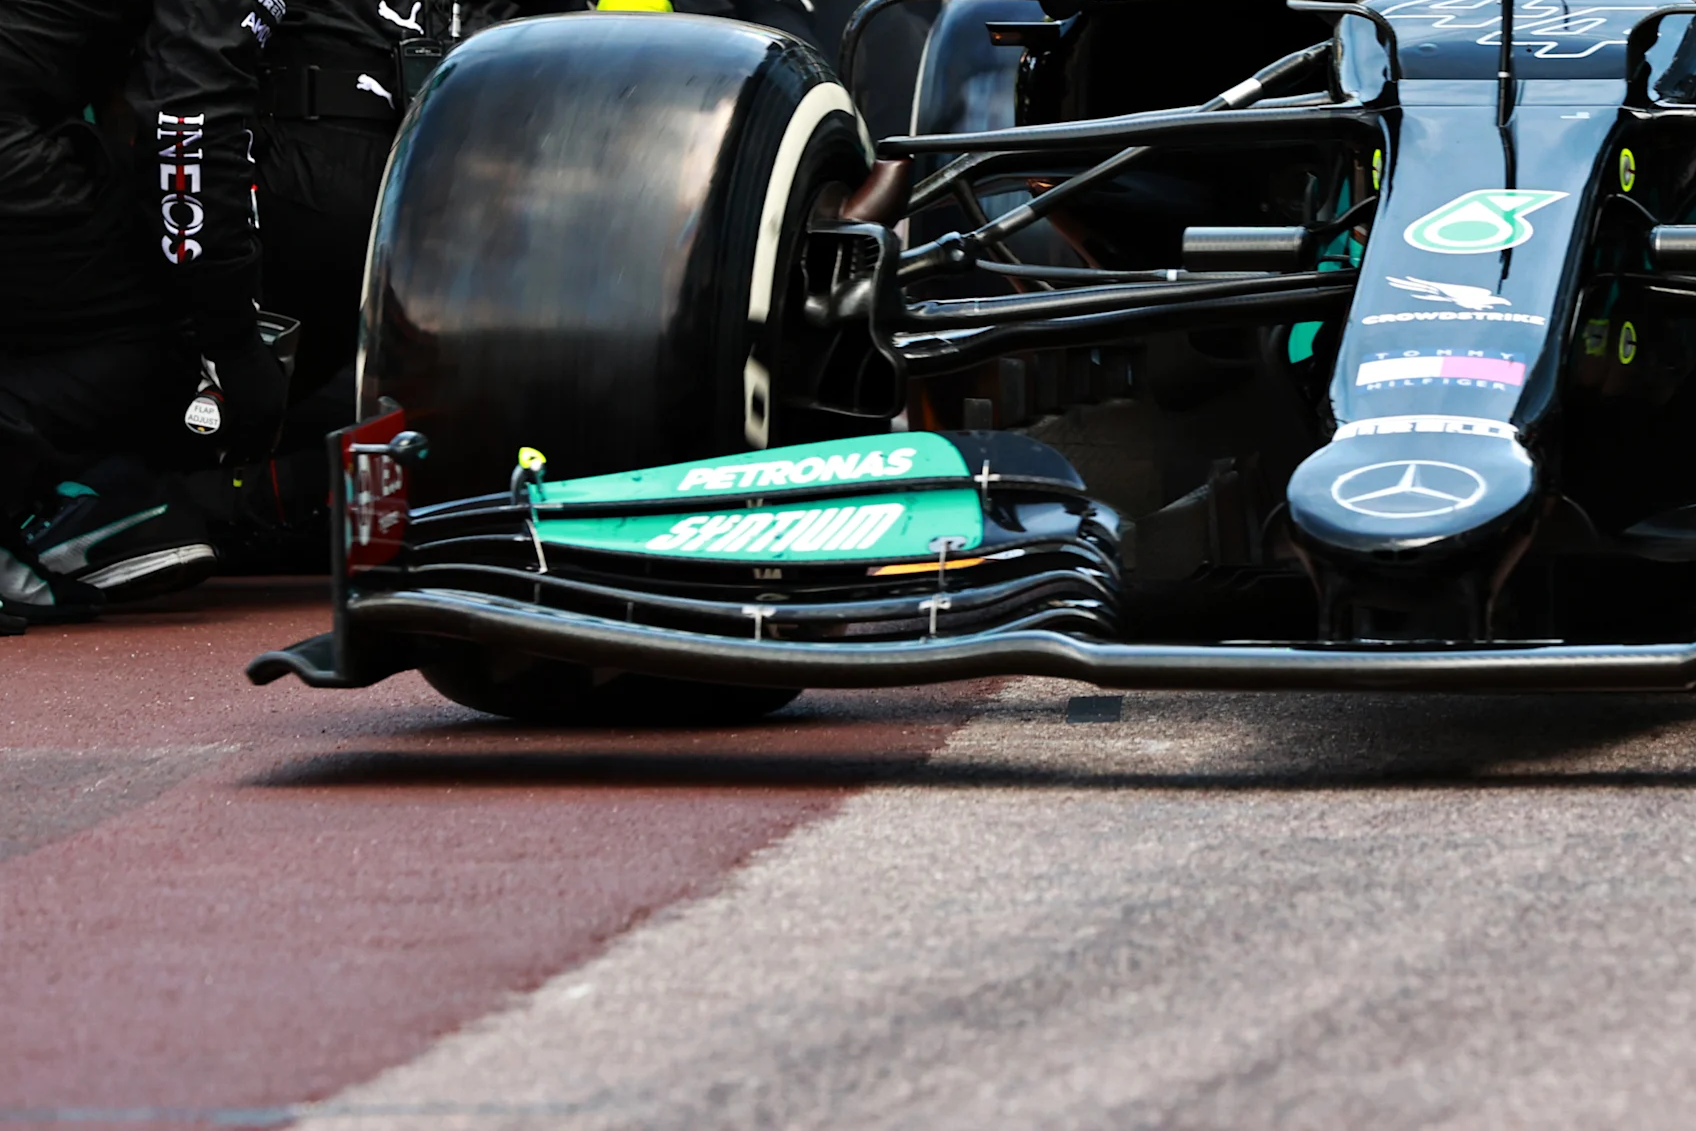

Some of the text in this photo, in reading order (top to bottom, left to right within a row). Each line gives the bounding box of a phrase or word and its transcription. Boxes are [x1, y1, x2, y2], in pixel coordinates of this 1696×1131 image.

[156, 111, 205, 265] INEOS
[1361, 311, 1546, 326] CROWDSTRIKE
[1374, 348, 1516, 361] TOMMY
[1365, 377, 1507, 392] HILFIGER
[194, 405, 215, 415] FLAP
[187, 414, 218, 426] ADJUST
[676, 447, 917, 491] PETRONAS
[644, 502, 906, 553] SYNTIUM
